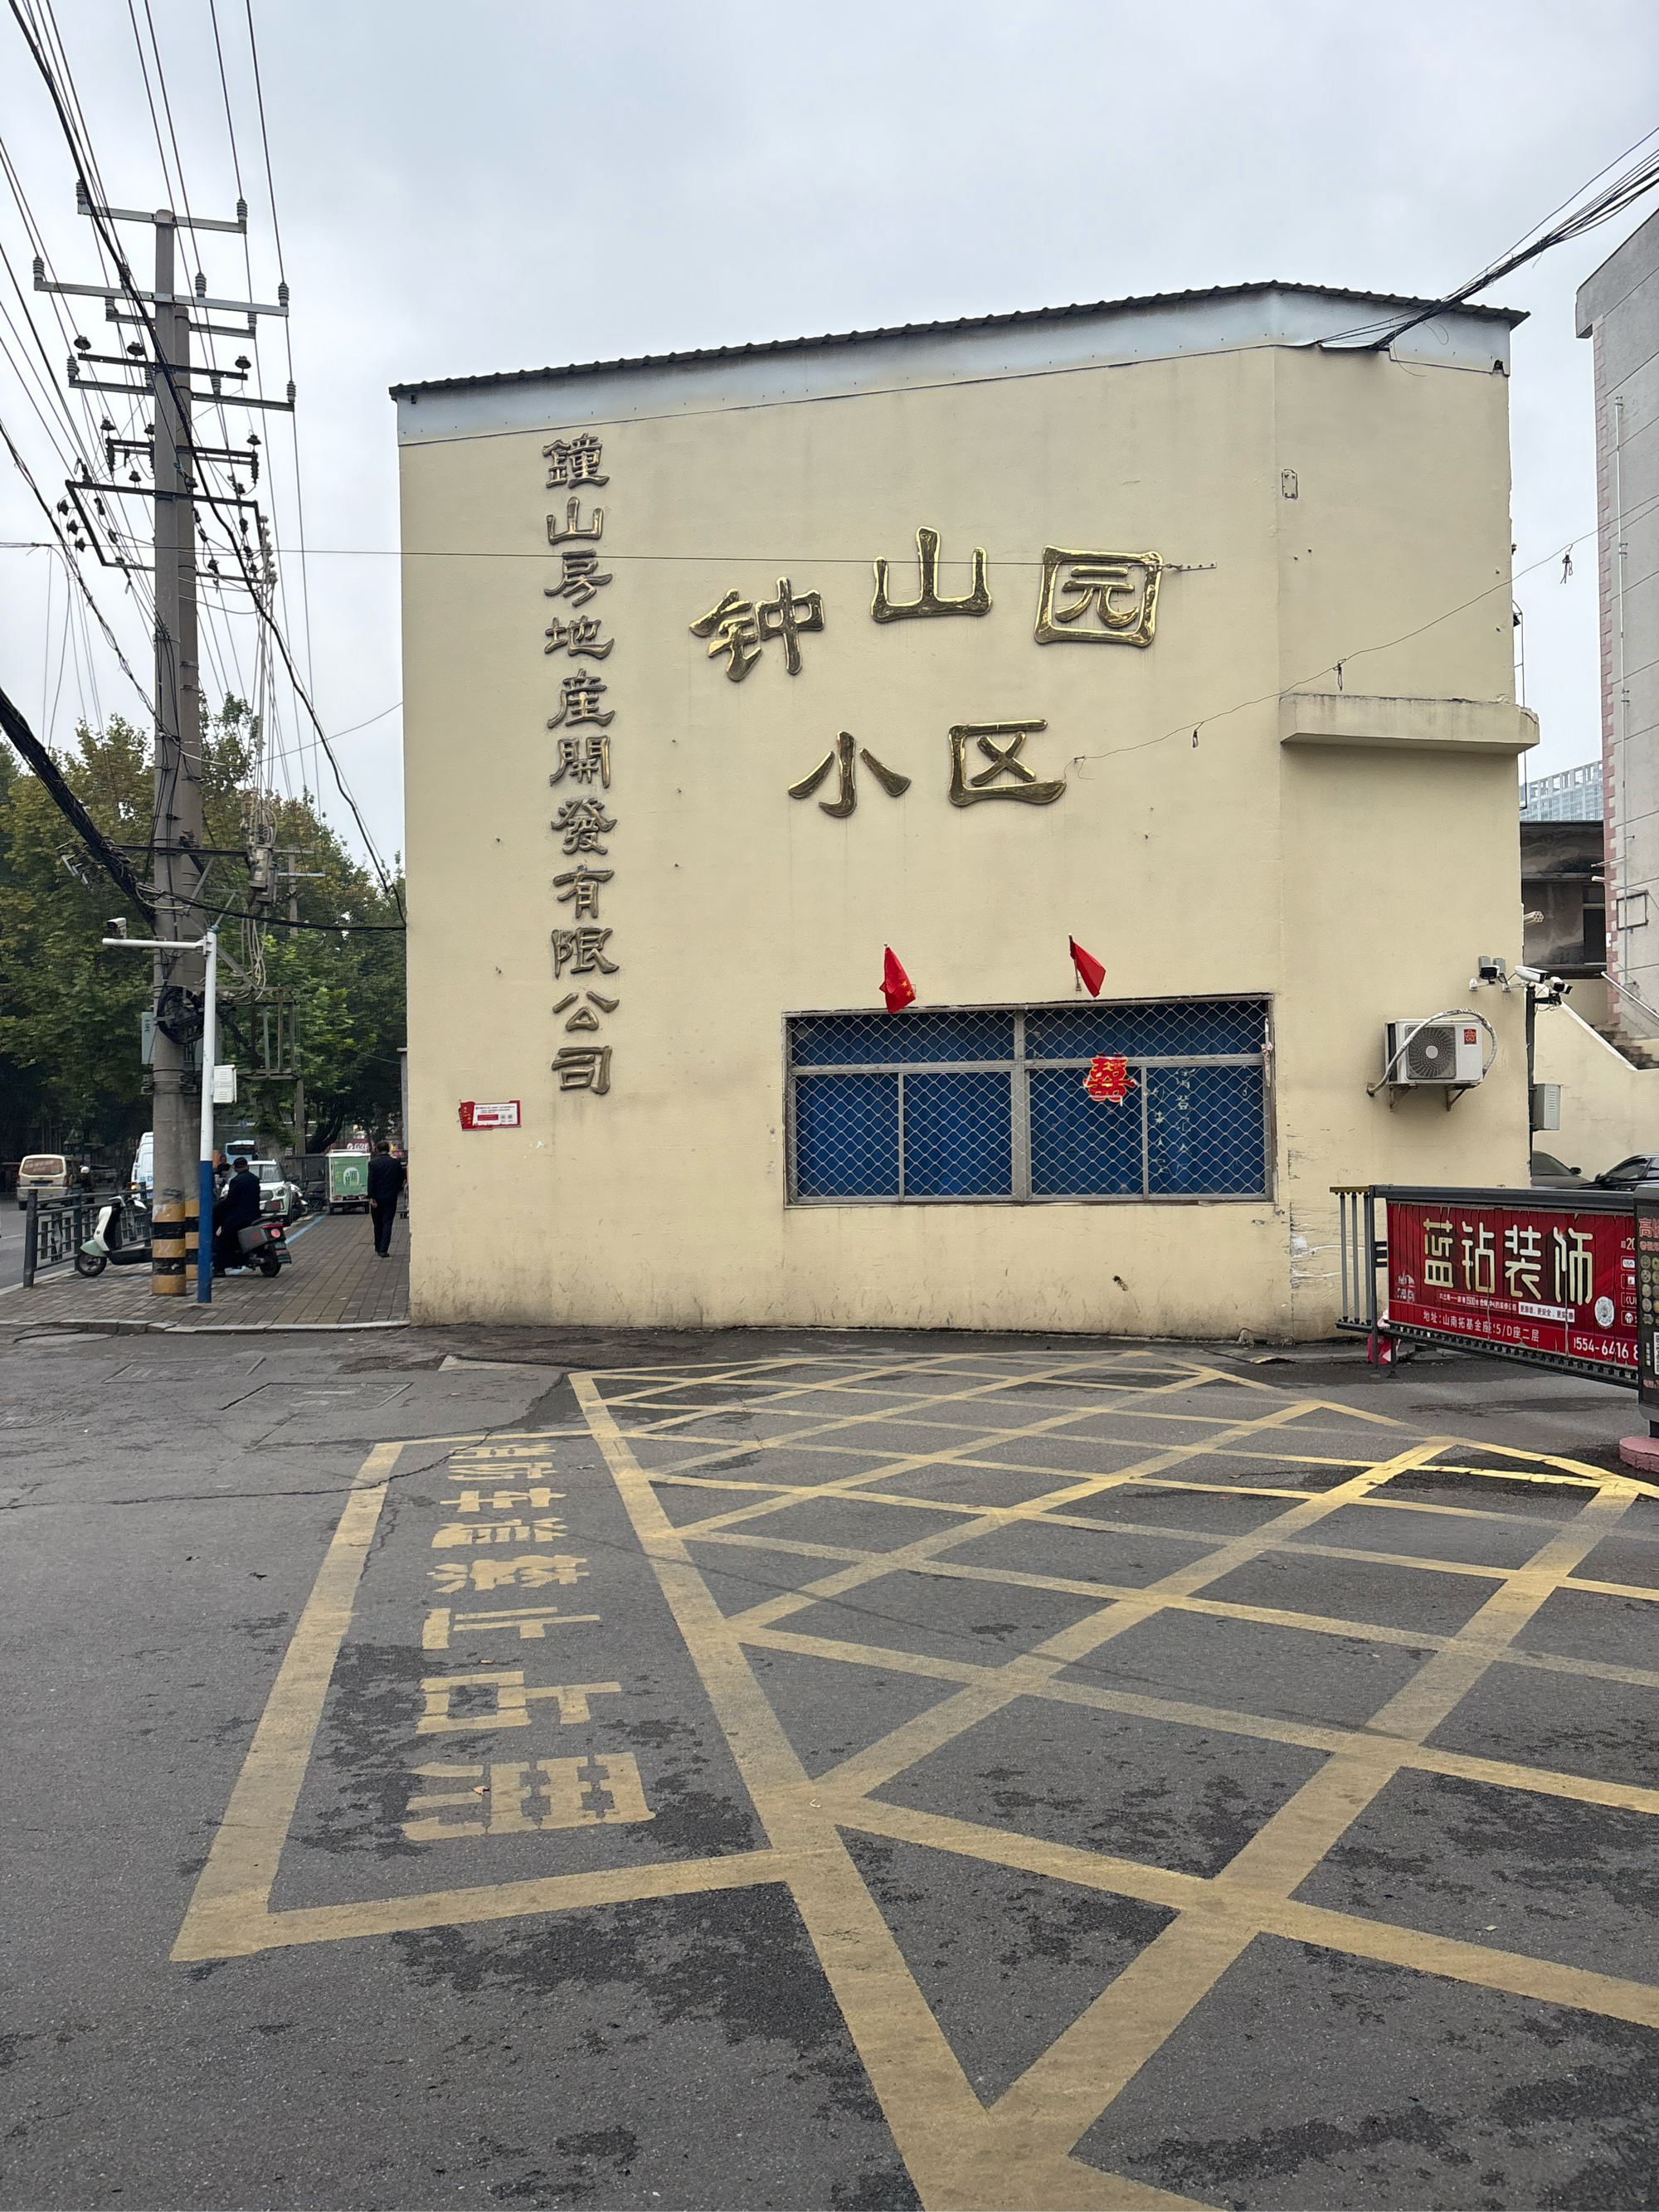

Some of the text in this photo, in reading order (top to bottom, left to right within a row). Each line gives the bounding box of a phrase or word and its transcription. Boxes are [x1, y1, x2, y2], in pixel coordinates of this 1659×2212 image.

[689, 526, 1163, 682] 钟山园
[788, 719, 1067, 818] 小区
[1423, 1218, 1593, 1305] 蓝钻装饰
